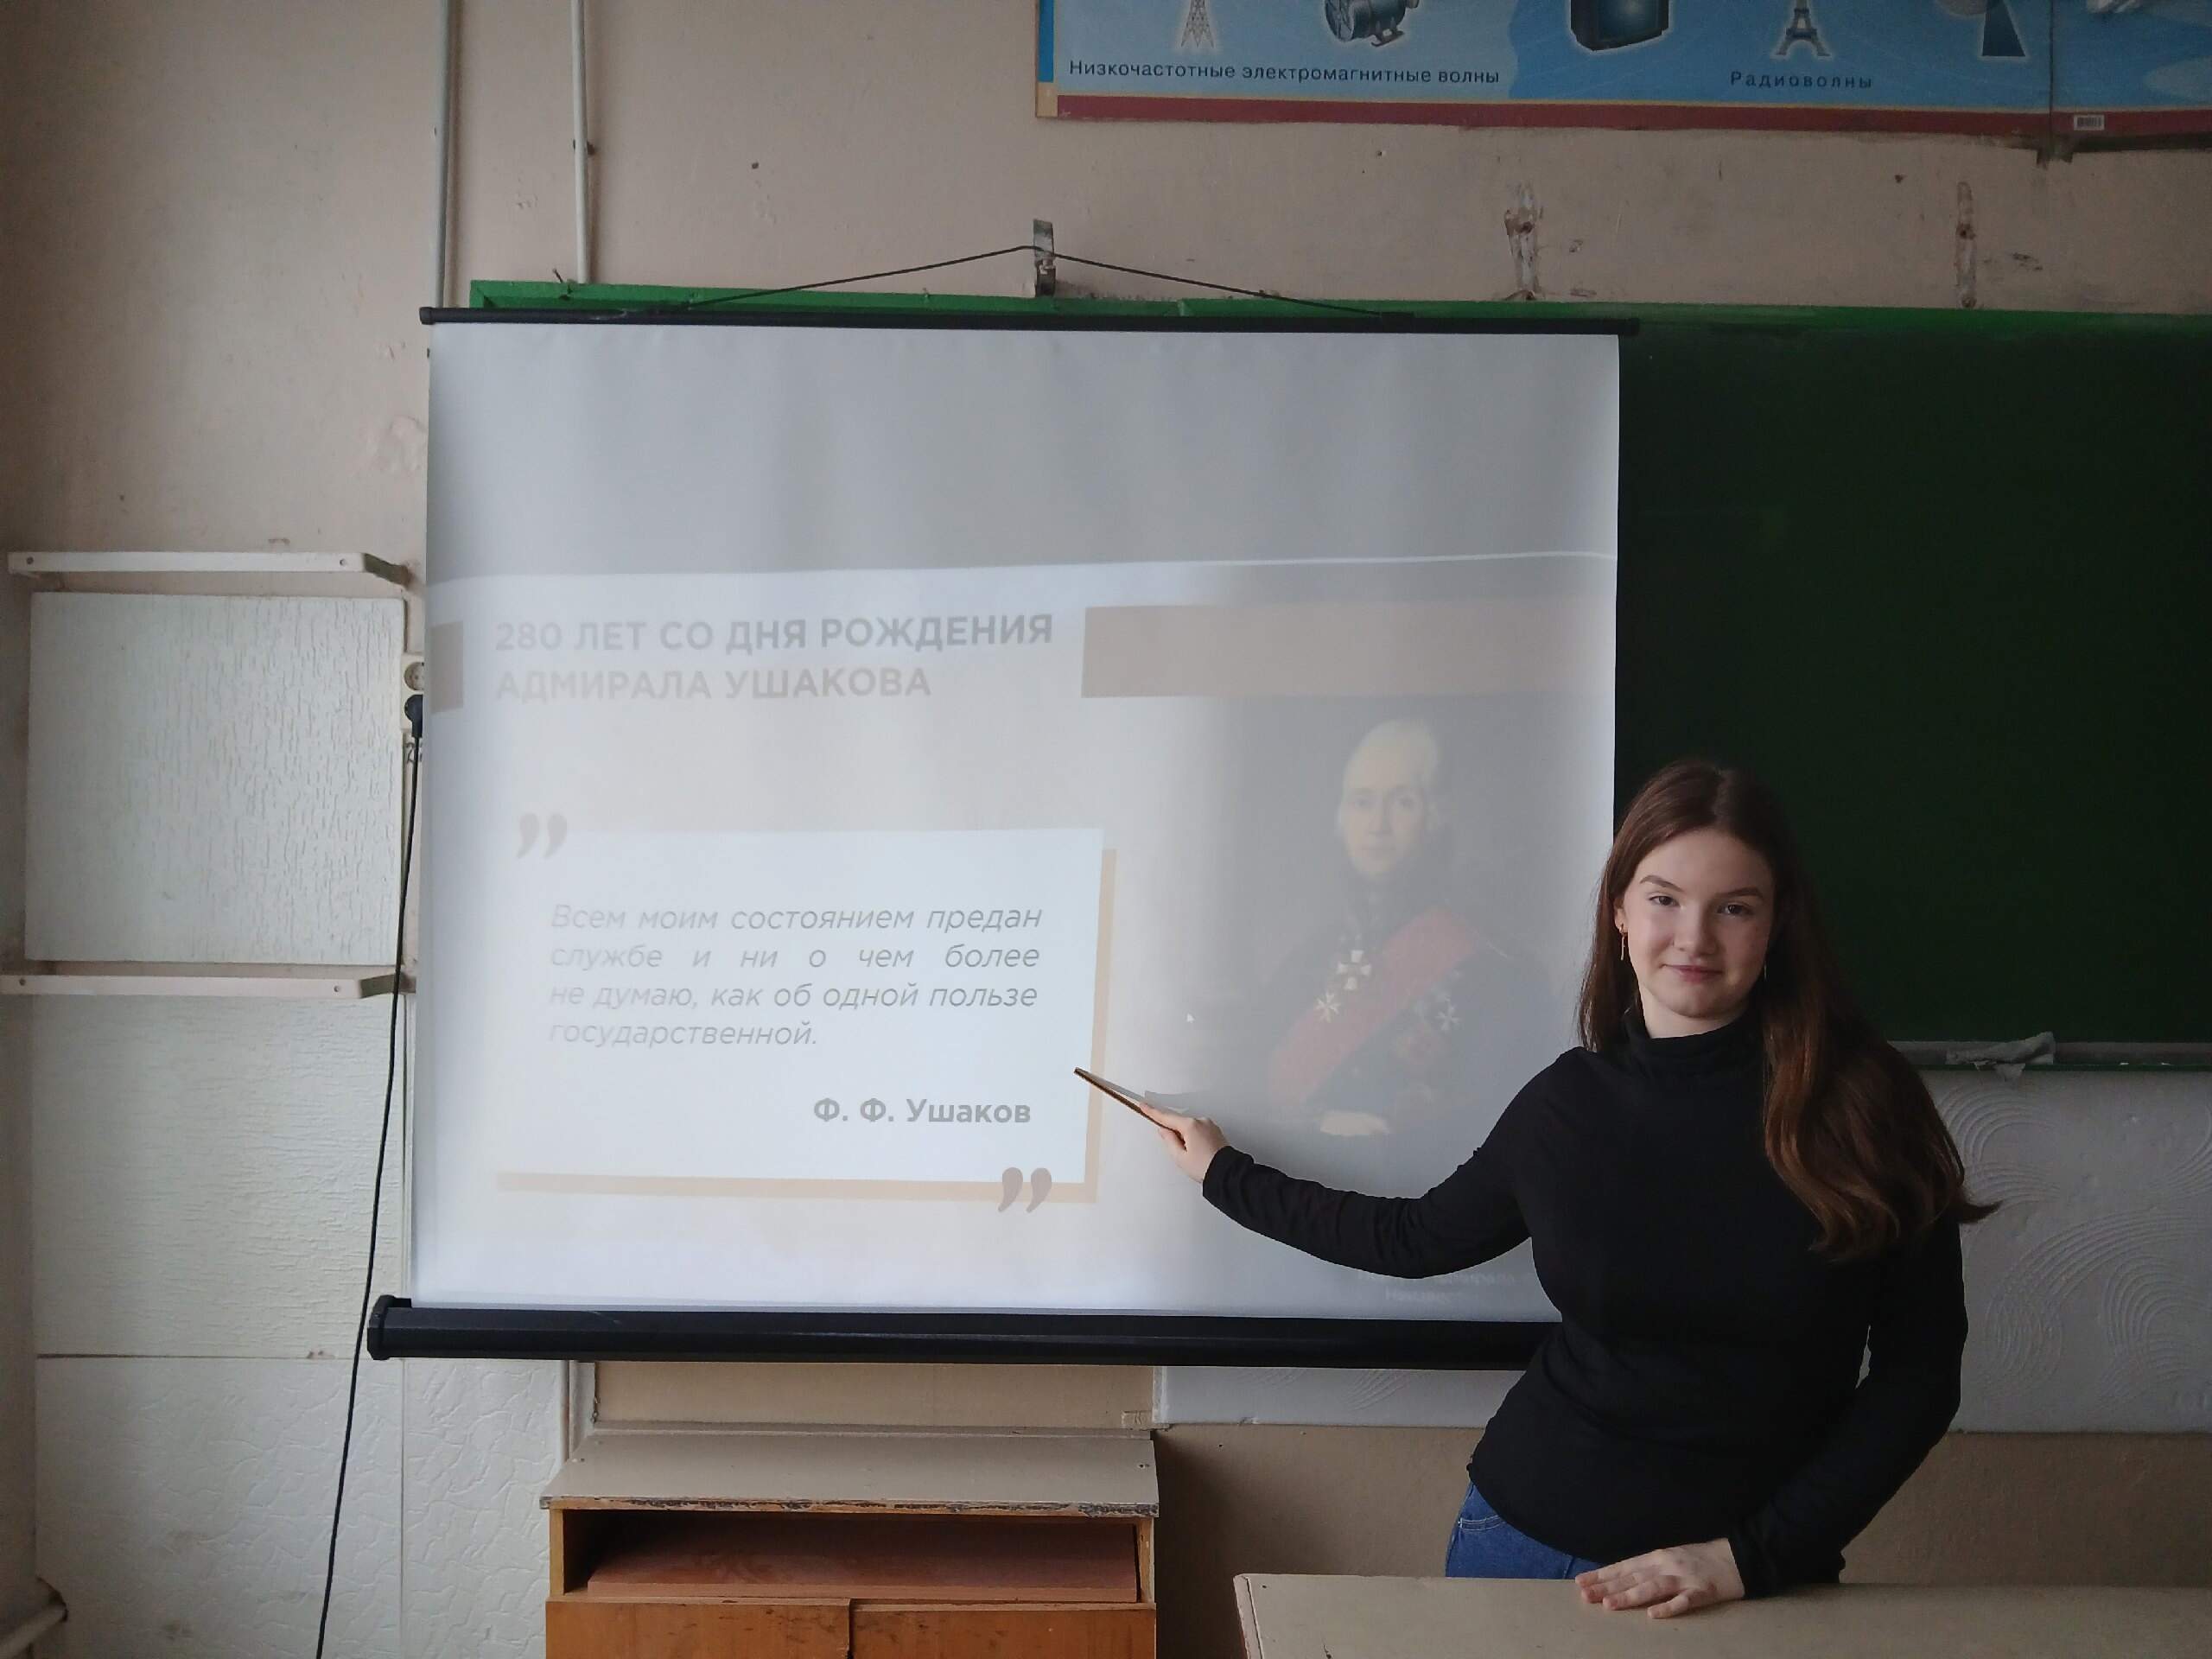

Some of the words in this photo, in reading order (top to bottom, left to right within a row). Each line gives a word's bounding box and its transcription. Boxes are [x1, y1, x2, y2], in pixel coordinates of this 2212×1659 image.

[1070, 60, 1235, 78] Низкочастотные
[1242, 67, 1431, 83] электромагнитные
[1438, 71, 1498, 83] волны
[1730, 70, 1871, 88] Радиоволны
[495, 621, 563, 651] 280
[573, 621, 646, 650] ЛЕТ
[659, 621, 713, 650] СО
[725, 619, 805, 655] ДНЯ
[821, 613, 1052, 652] РОЖДЕНИЯ
[496, 670, 711, 704] АДМИРАЛА
[724, 667, 931, 698] УШАКОВА
[550, 903, 626, 929] Всем
[638, 910, 718, 929] моим
[730, 909, 914, 929] состоянием
[925, 909, 1042, 933] предан
[550, 944, 664, 971] службе
[691, 950, 712, 968] и
[740, 950, 778, 968] ни
[809, 949, 826, 968] о
[859, 949, 914, 967] чем
[944, 943, 1039, 967] более
[549, 986, 584, 1004] не
[592, 987, 697, 1009] думаю,
[710, 988, 760, 1007] как
[773, 982, 812, 1007] об
[823, 982, 918, 1010] одной
[929, 988, 1037, 1007] пользе
[550, 1020, 816, 1048] государственной.
[813, 1097, 848, 1122] Ф.
[860, 1097, 893, 1122] Ф.
[906, 1098, 1030, 1122] Ушаков
